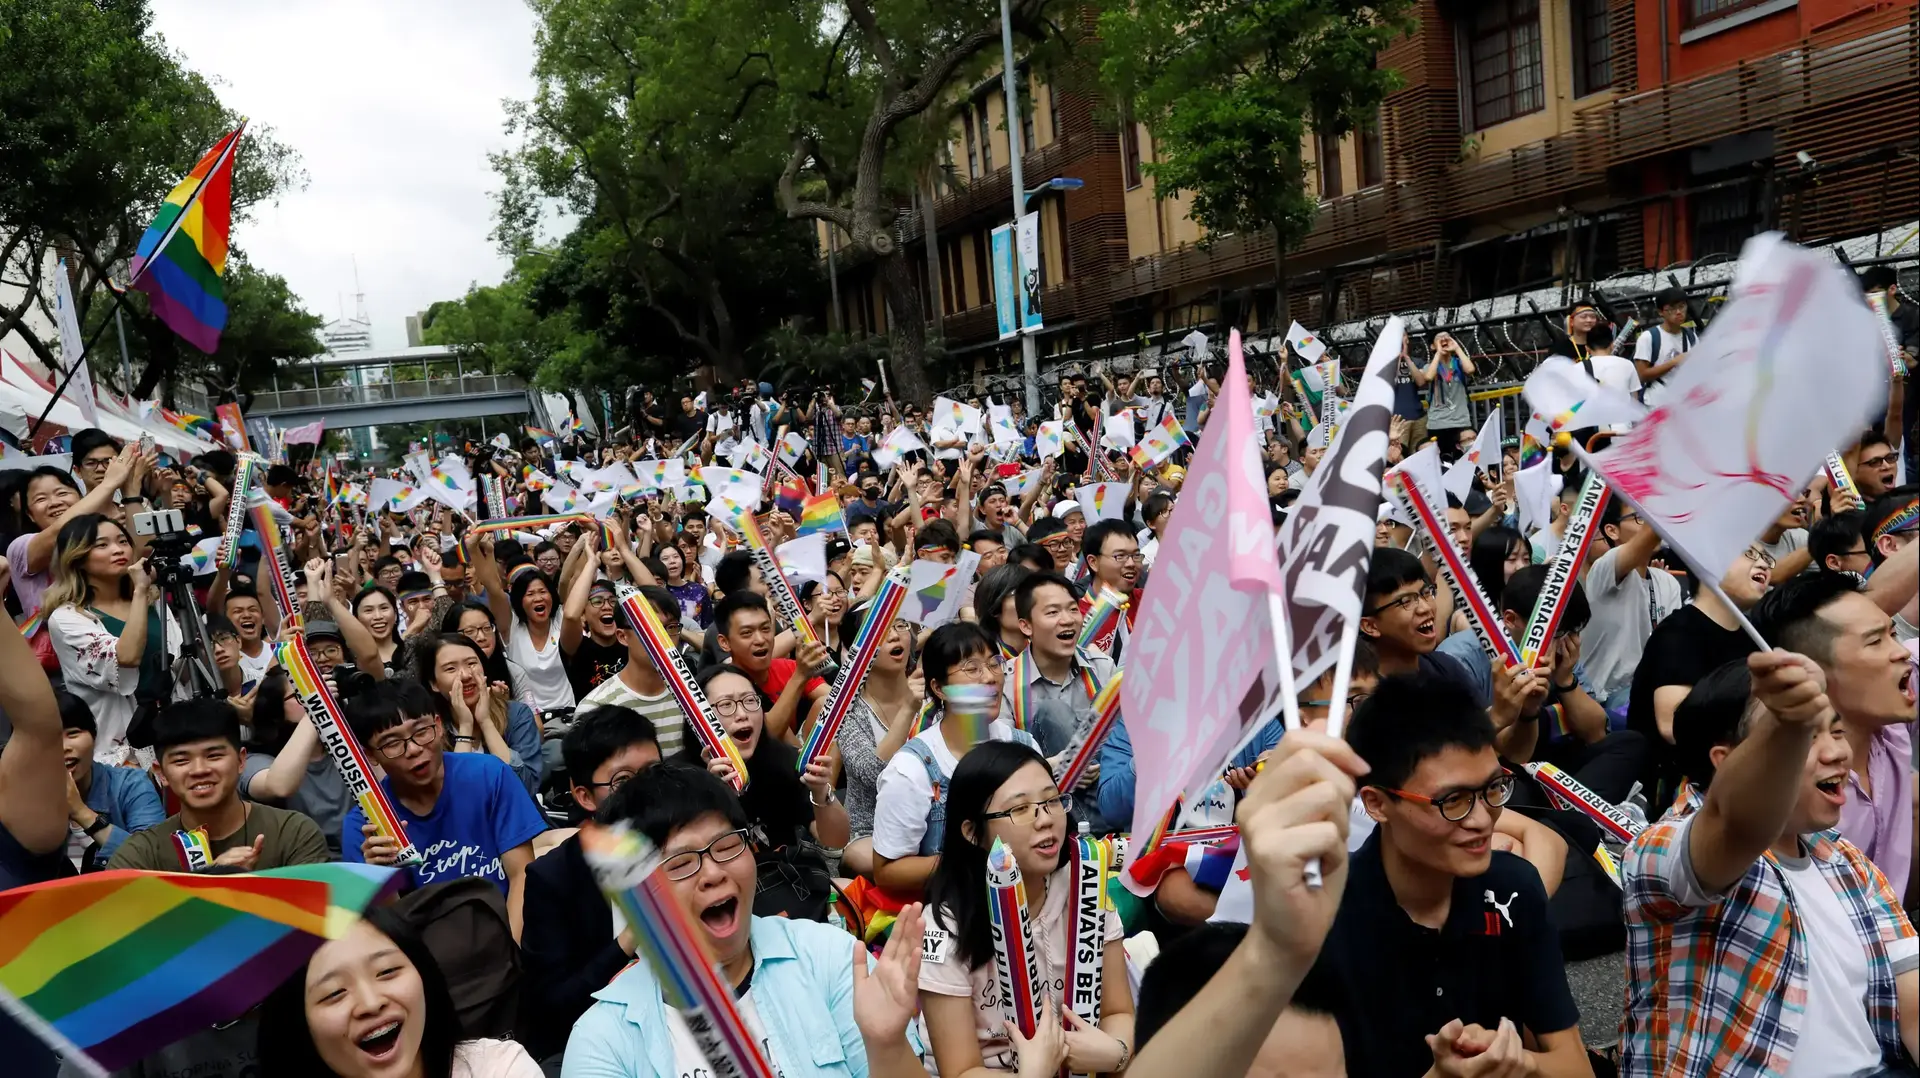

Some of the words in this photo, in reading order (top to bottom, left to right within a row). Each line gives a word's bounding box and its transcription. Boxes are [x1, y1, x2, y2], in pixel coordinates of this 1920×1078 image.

[231, 468, 246, 516] MARRIAGE
[289, 591, 301, 615] WEI
[757, 548, 776, 573] WEI
[772, 575, 800, 619] HOUSE
[1526, 556, 1575, 650] MARRIAGE
[1441, 568, 1498, 660] MARRIAGE
[668, 648, 706, 704] HOUSE
[306, 693, 334, 731] WEI
[326, 731, 369, 796] HOUSE
[703, 704, 726, 738] WEI
[1553, 771, 1626, 822] MARRIAGE
[418, 845, 481, 884] Stop
[1077, 863, 1099, 965] ALWAYS
[923, 938, 943, 954] AY
[1075, 973, 1094, 1005] BE
